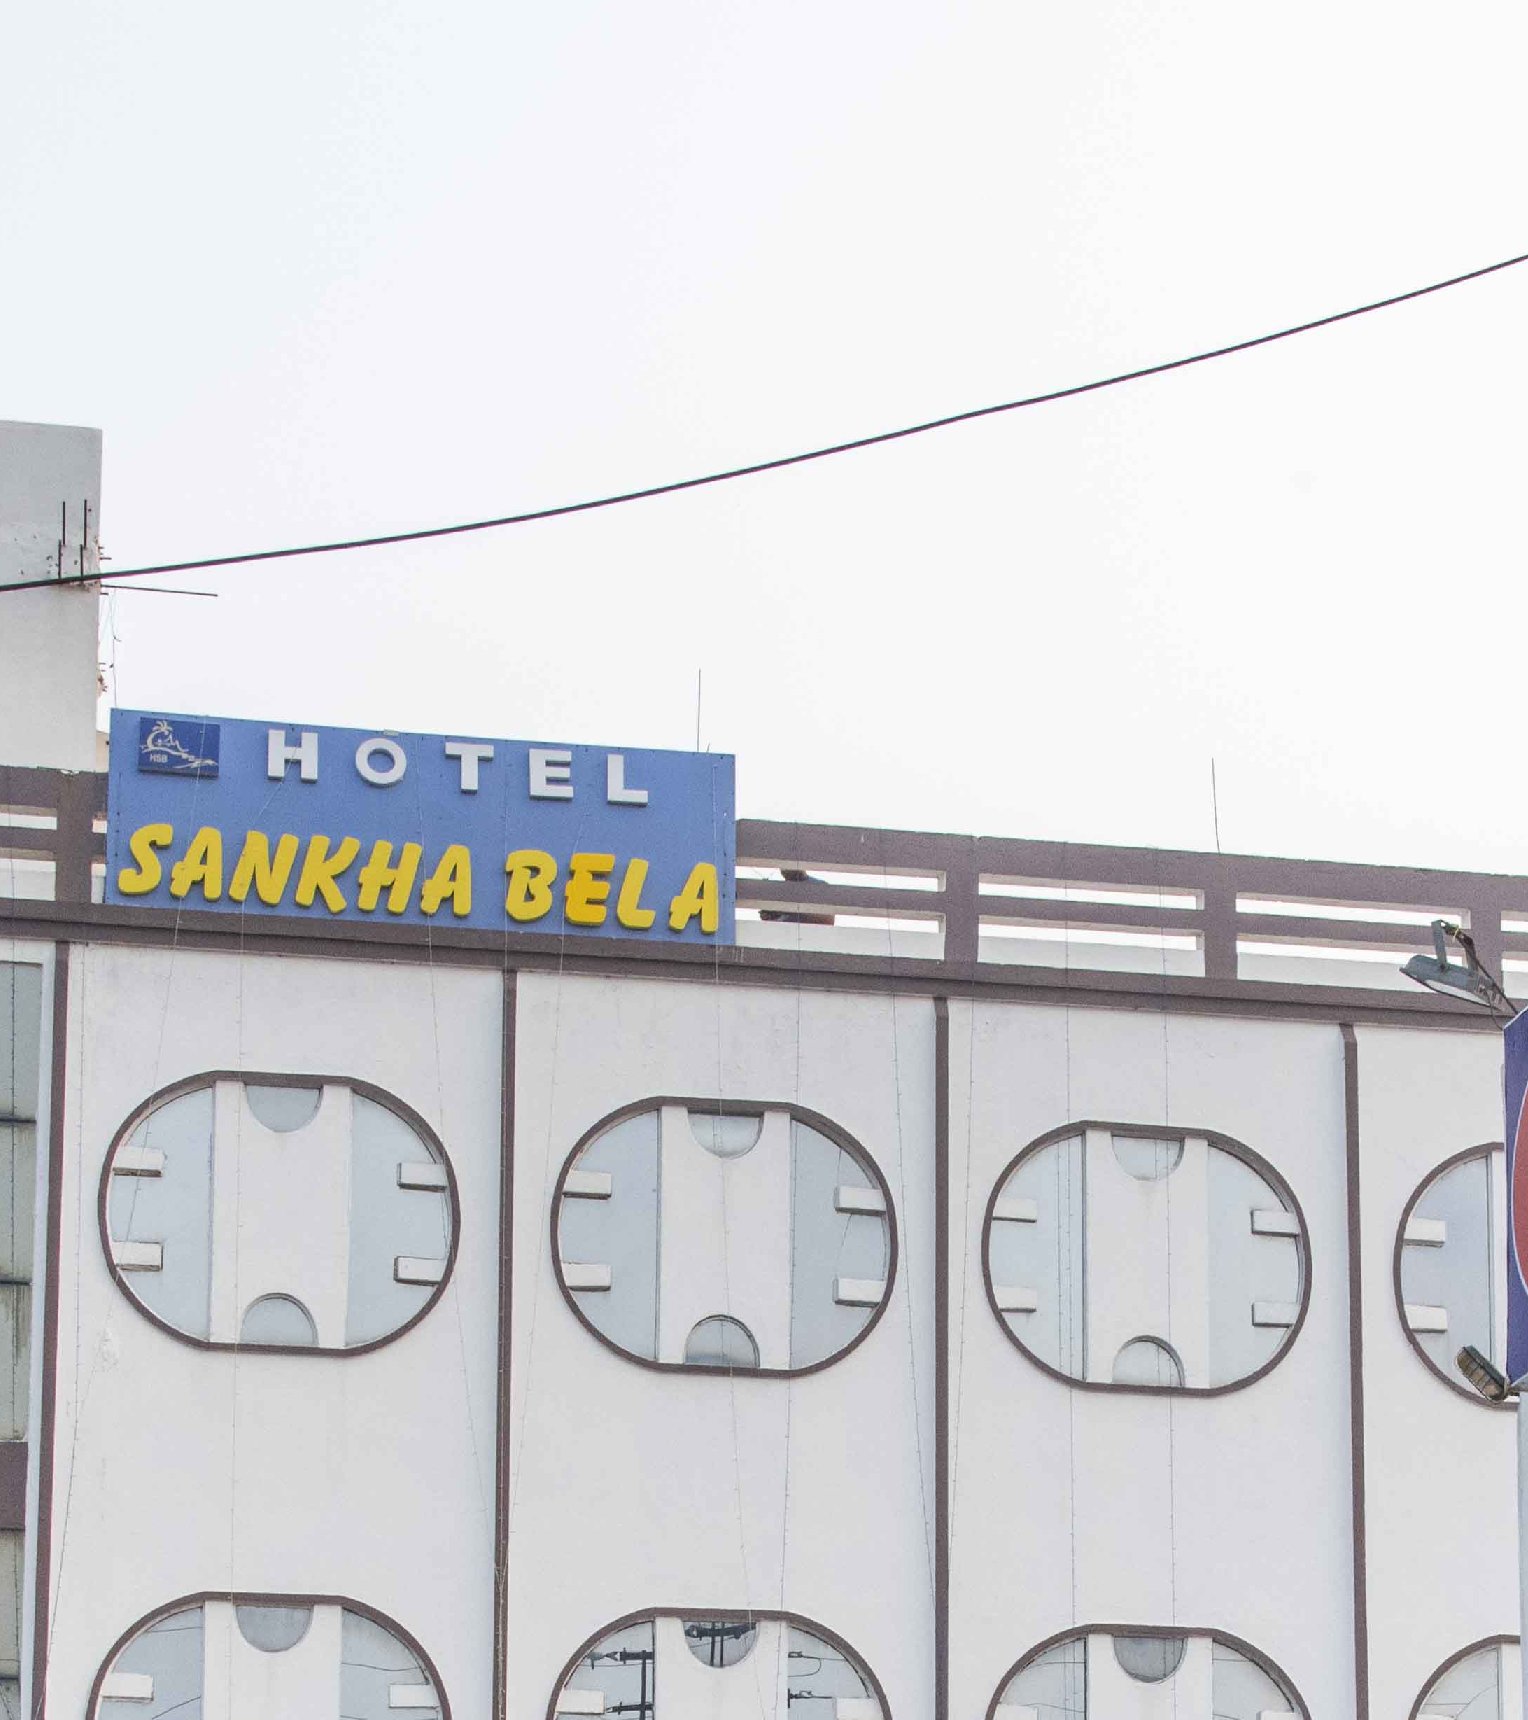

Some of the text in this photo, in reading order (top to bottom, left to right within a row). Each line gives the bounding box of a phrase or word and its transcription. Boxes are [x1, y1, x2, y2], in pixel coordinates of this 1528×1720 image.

[150, 754, 168, 763] HSB
[267, 729, 649, 806] HOTEL
[117, 823, 718, 934] SANKHA BELA
